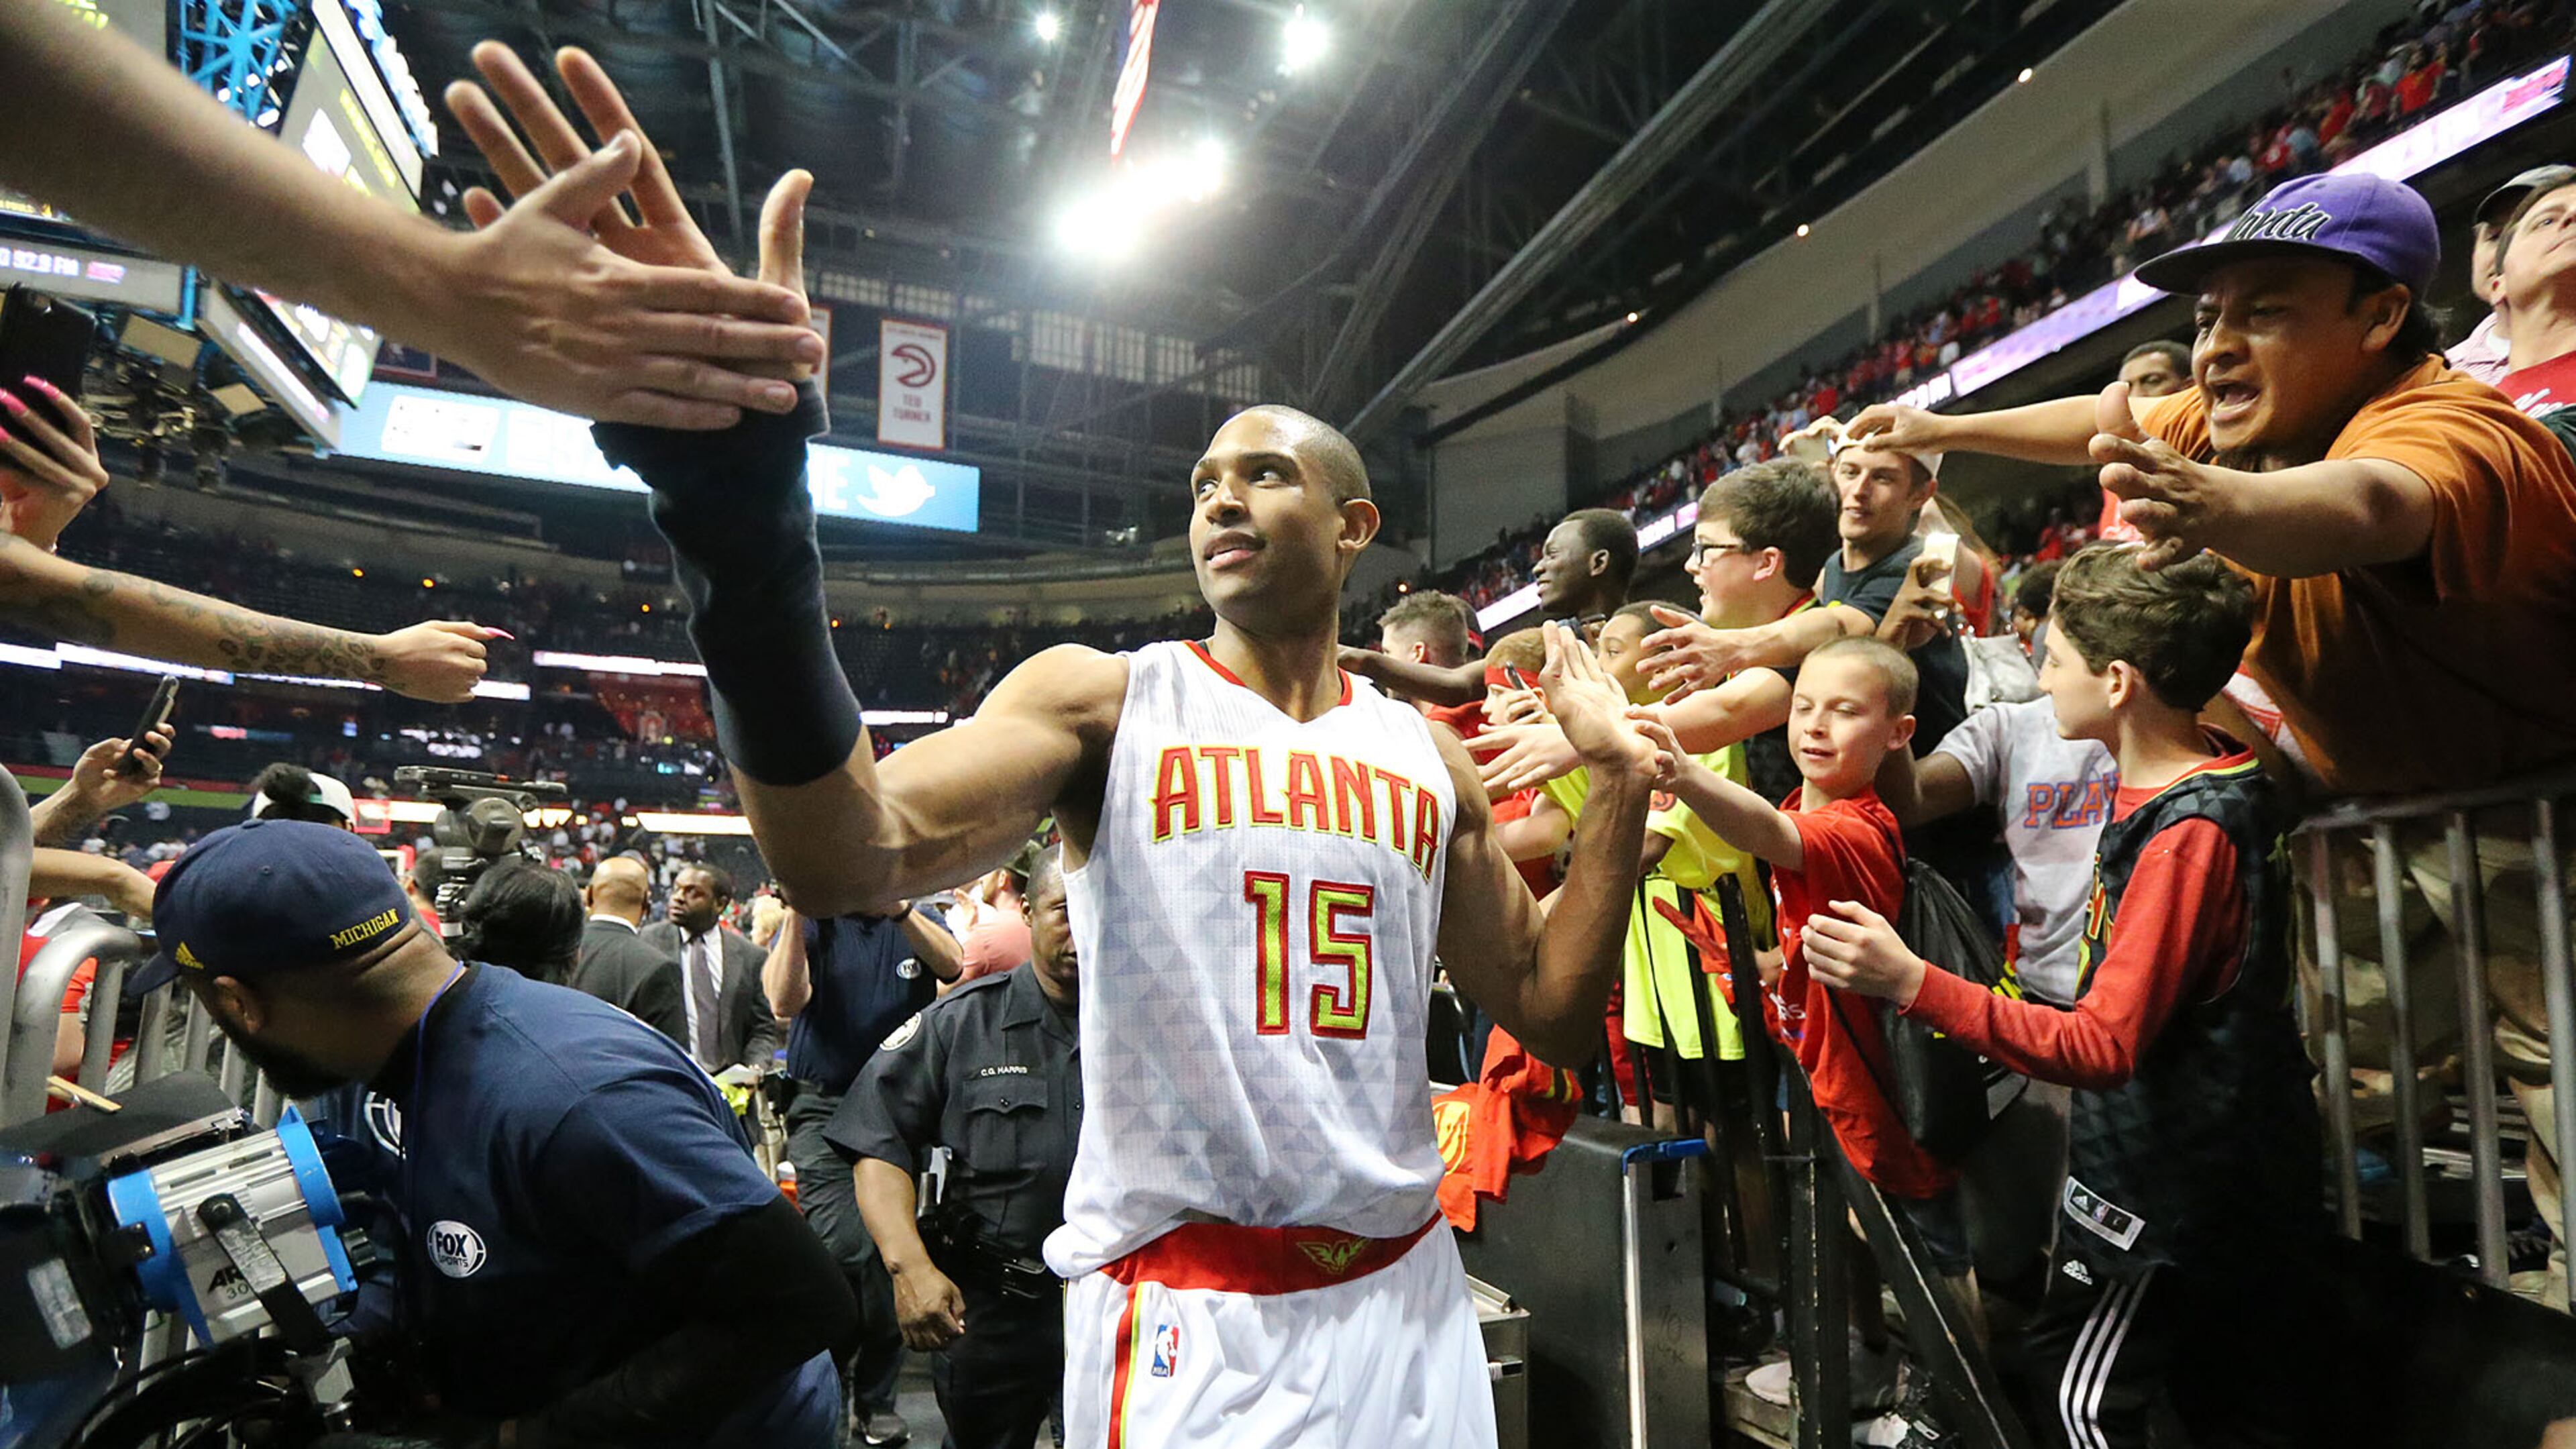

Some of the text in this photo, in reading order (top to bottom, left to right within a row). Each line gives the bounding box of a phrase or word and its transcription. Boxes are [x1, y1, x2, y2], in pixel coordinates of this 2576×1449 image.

[53, 256, 80, 277] FM
[1148, 745, 1440, 884] ATLANTA
[329, 908, 400, 951] MICHIGAN
[1244, 870, 1374, 1039] 15
[998, 1065, 1028, 1075] HARRIS
[435, 1230, 468, 1258] FOX
[437, 1254, 469, 1268] SPORTS
[226, 1283, 248, 1299] 30
